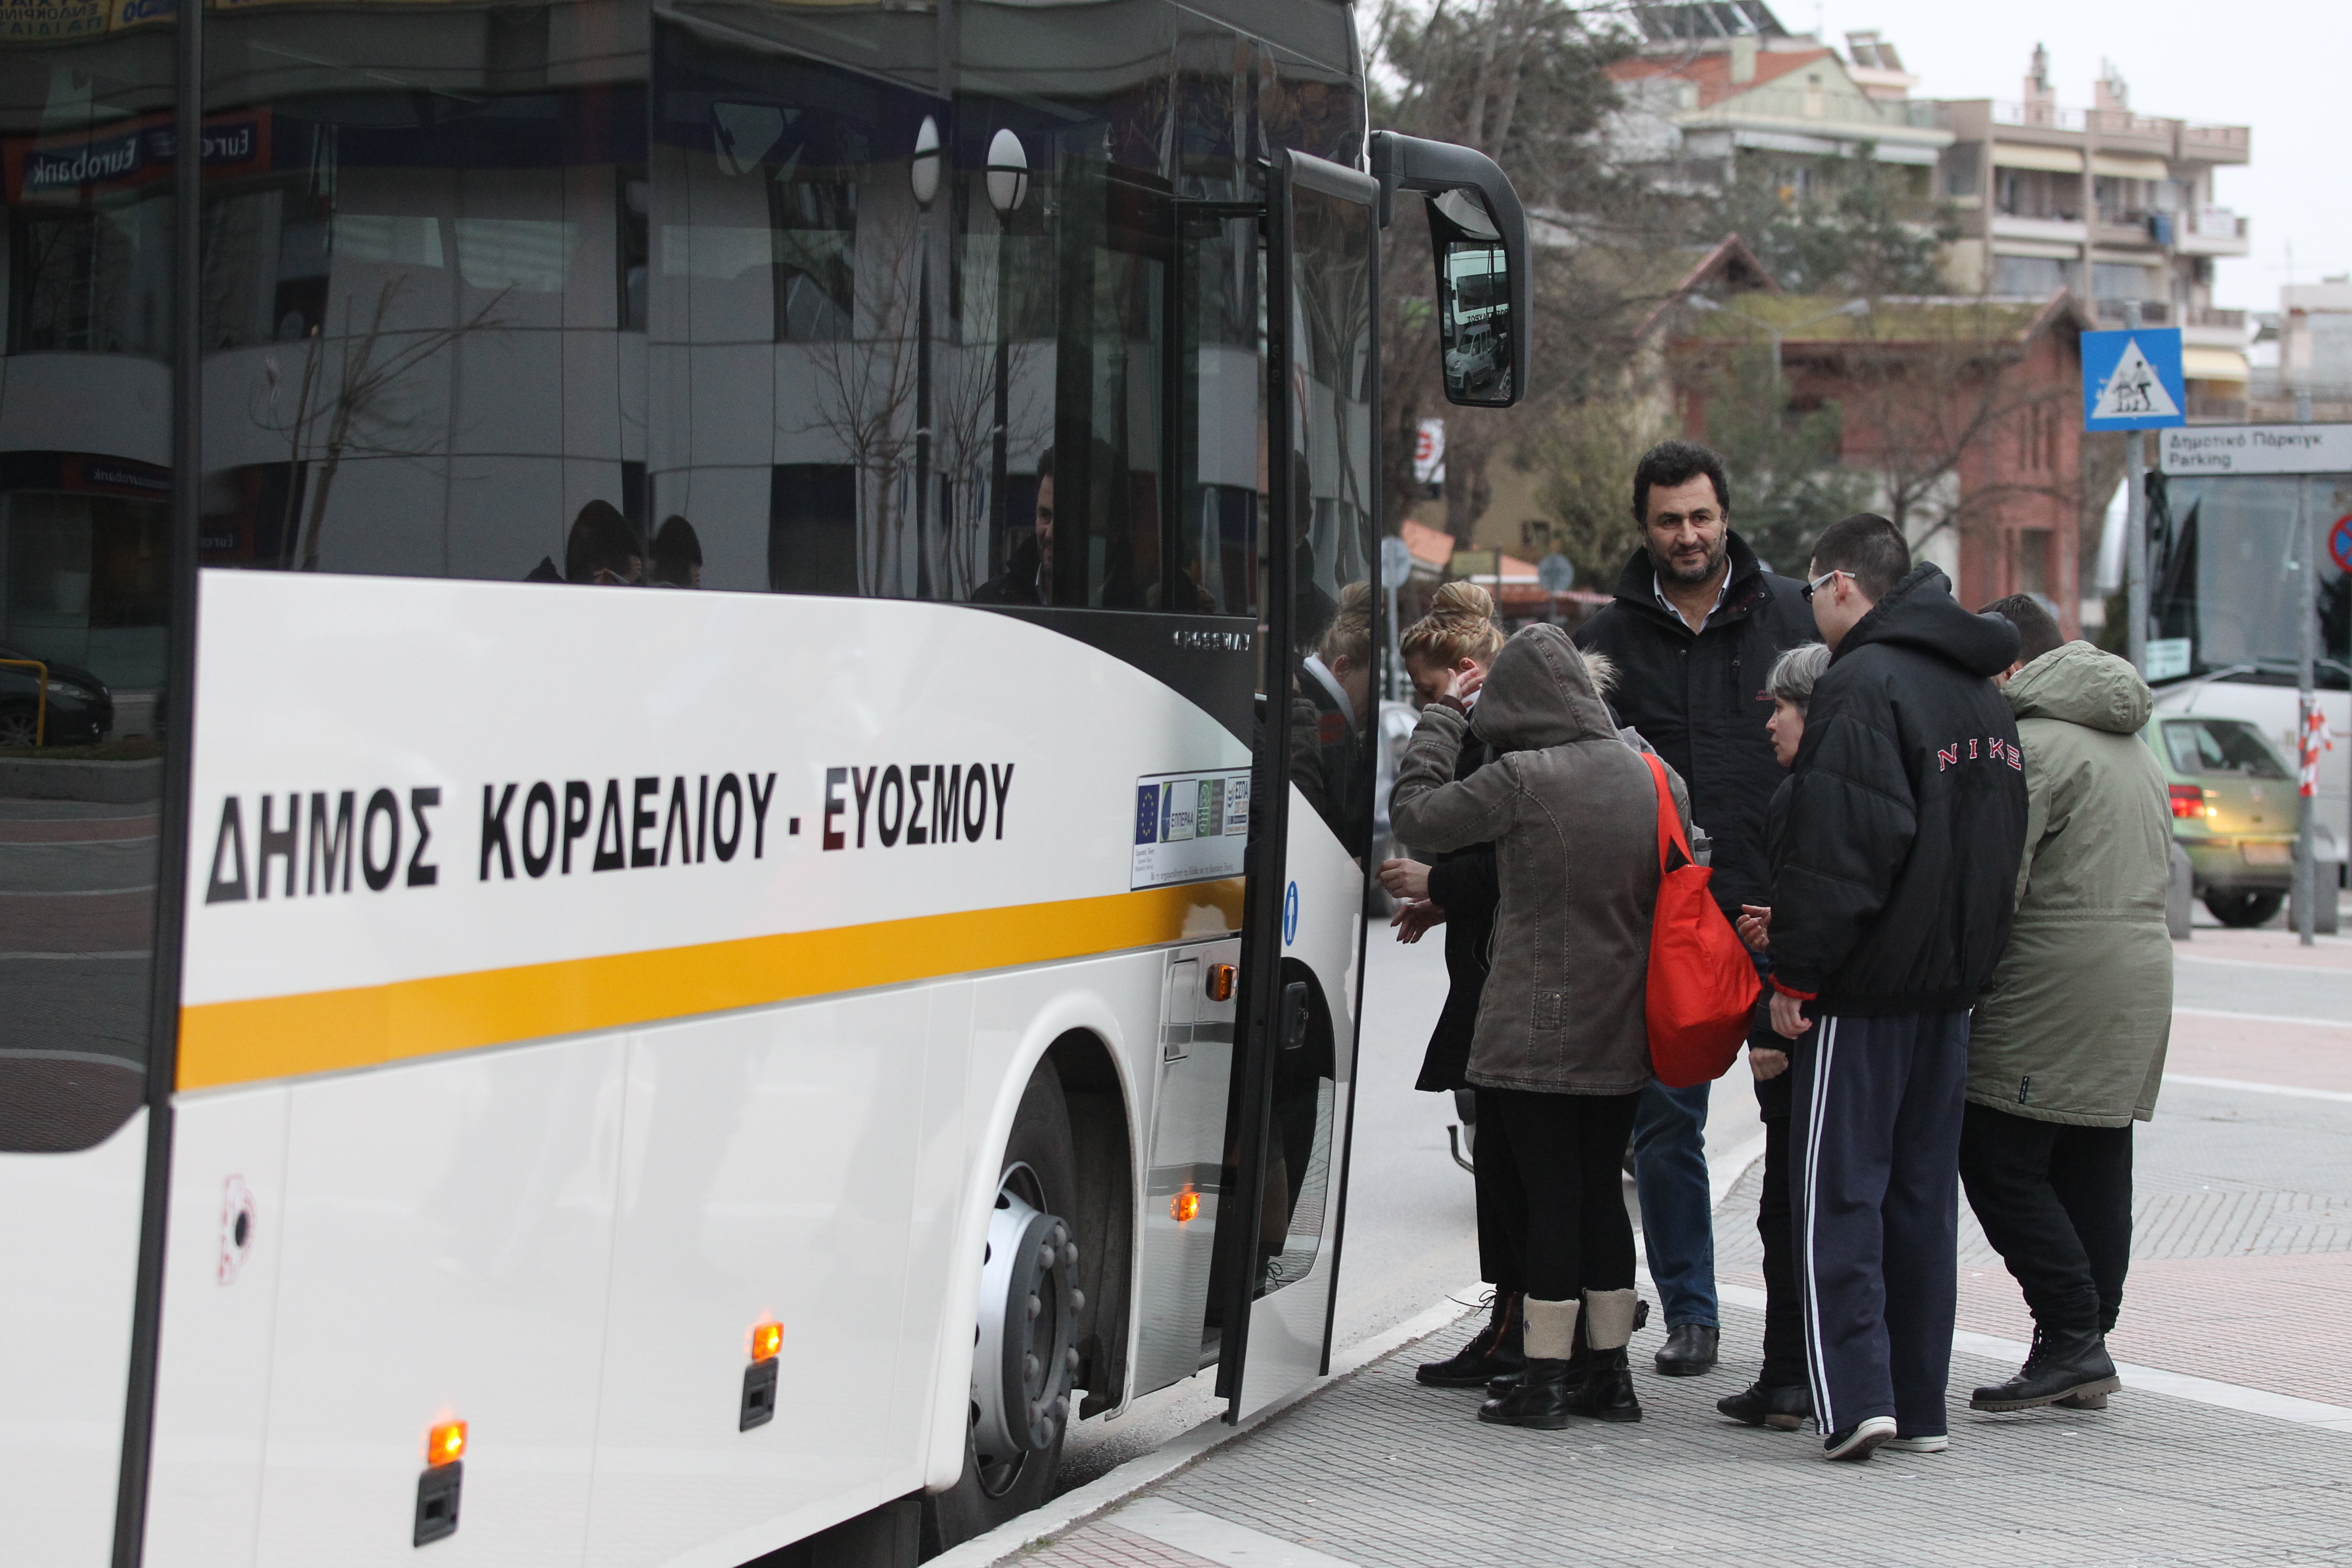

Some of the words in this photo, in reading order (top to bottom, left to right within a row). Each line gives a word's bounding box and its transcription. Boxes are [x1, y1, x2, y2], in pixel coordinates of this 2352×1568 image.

[2169, 452, 2231, 469] Parking
[1937, 737, 2021, 772] NIKE
[204, 786, 441, 906] ΔΗΜΟΣ
[479, 771, 778, 882] ΚΟΡΔΕΛΙΟΥ
[822, 762, 1015, 851] ΕΥΟΣΜΟΥ
